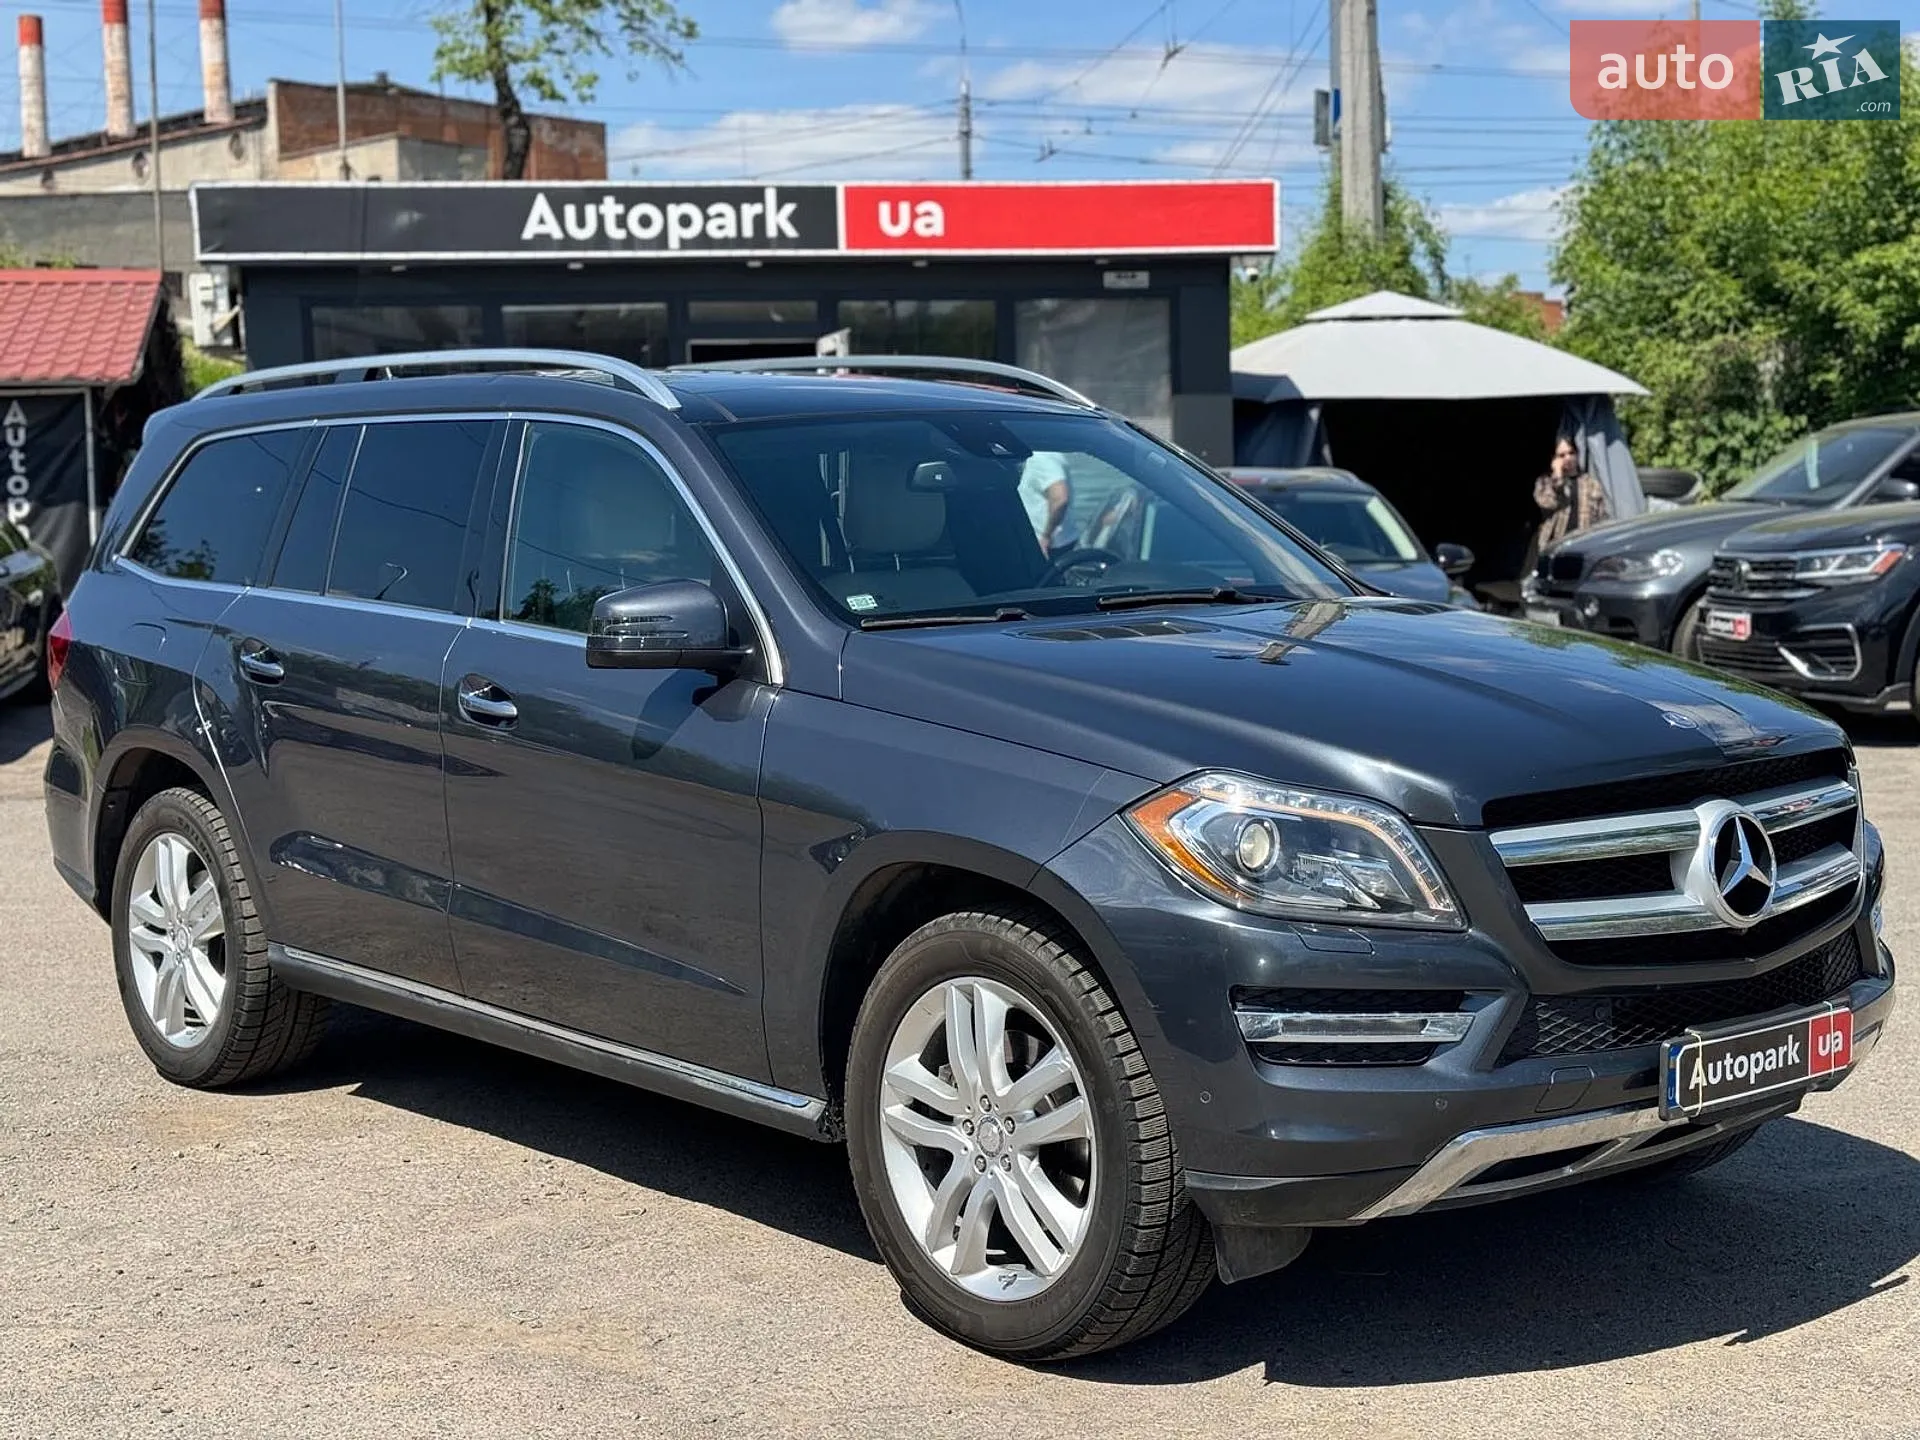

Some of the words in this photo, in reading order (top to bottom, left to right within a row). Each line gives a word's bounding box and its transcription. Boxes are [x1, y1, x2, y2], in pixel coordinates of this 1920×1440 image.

[520, 186, 800, 250] Autopark
[878, 199, 945, 239] ua
[1688, 1033, 1801, 1091] Autopark
[1817, 1028, 1844, 1057] ua
